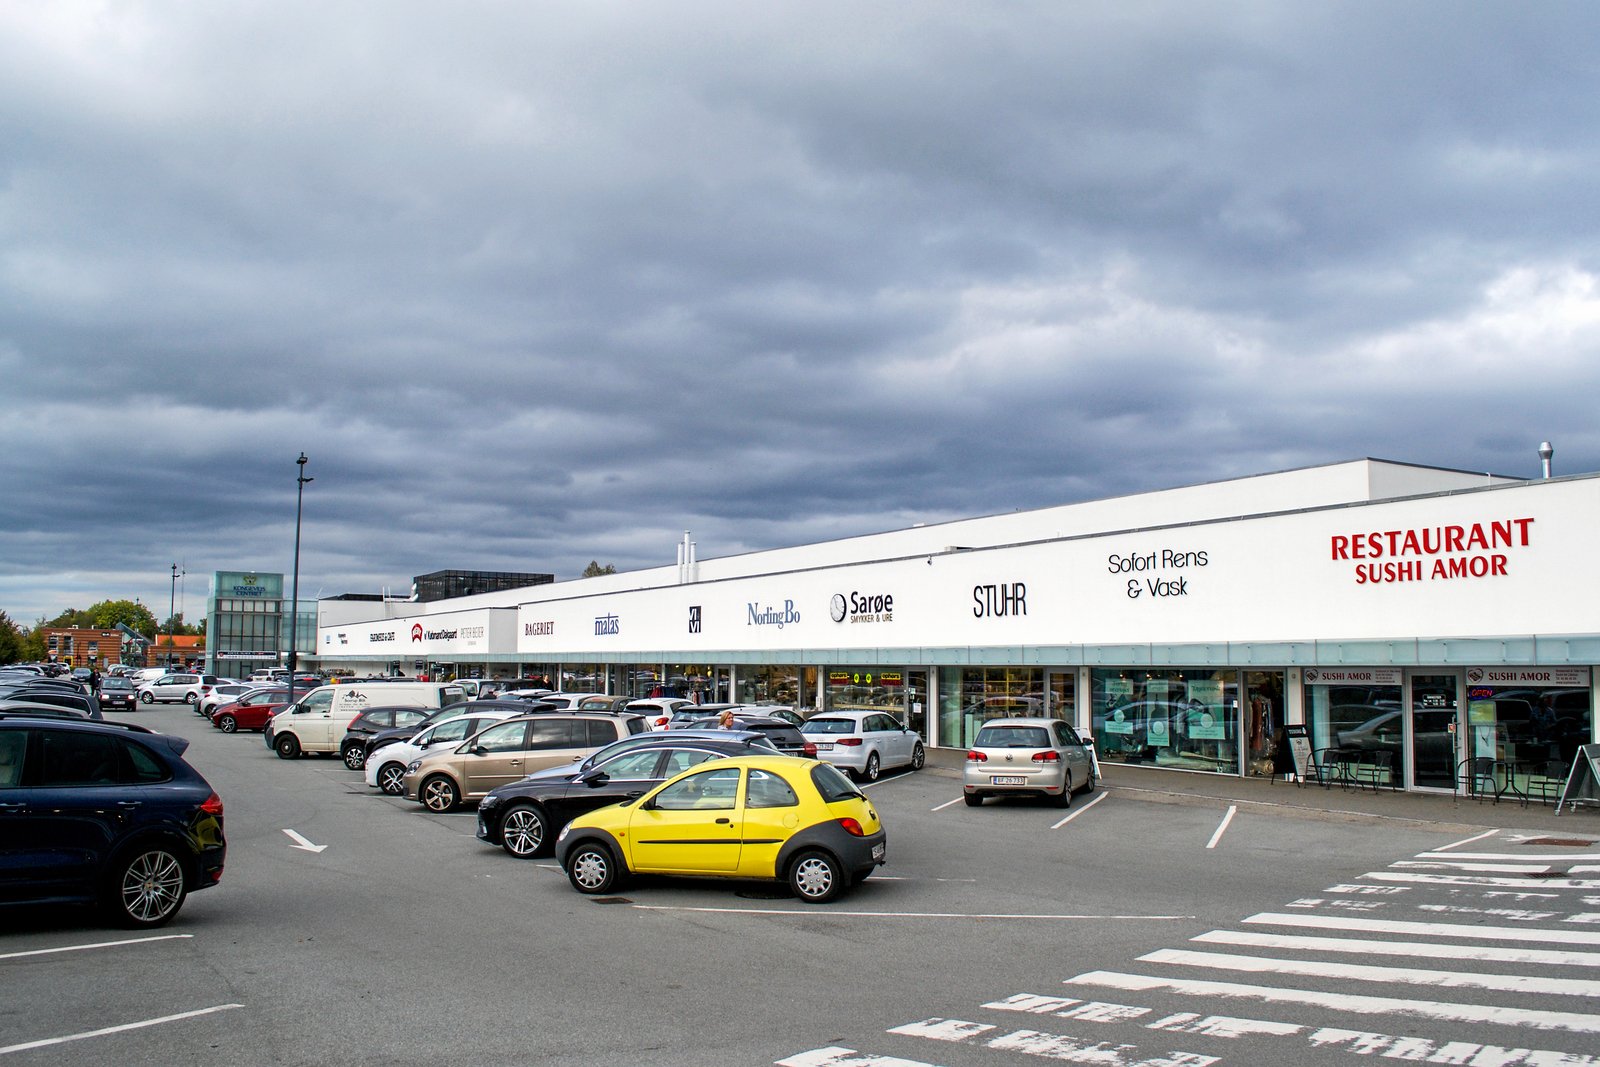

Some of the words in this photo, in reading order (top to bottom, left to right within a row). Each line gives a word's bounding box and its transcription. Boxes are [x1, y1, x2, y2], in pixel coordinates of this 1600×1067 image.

[1331, 517, 1535, 561] RESTAURANT
[1108, 551, 1157, 574] Sofort
[1162, 549, 1208, 568] Rens
[1356, 561, 1422, 584] SUSHI
[1432, 554, 1508, 580] AMOR
[1127, 579, 1143, 599] &
[1147, 576, 1187, 597] Vask
[850, 591, 893, 614] Sarøe
[973, 582, 1027, 618] STUHR
[525, 621, 555, 636] BAGERIET
[594, 612, 620, 636] matas
[850, 614, 875, 624] SMYKKER
[876, 614, 880, 622] &
[882, 613, 893, 622] URE
[1322, 672, 1345, 681] SUSHI
[1347, 672, 1372, 681] AMOR
[1488, 672, 1517, 681] SUSHI
[1520, 672, 1551, 681] AMOR
[1471, 689, 1493, 697] OPEN
